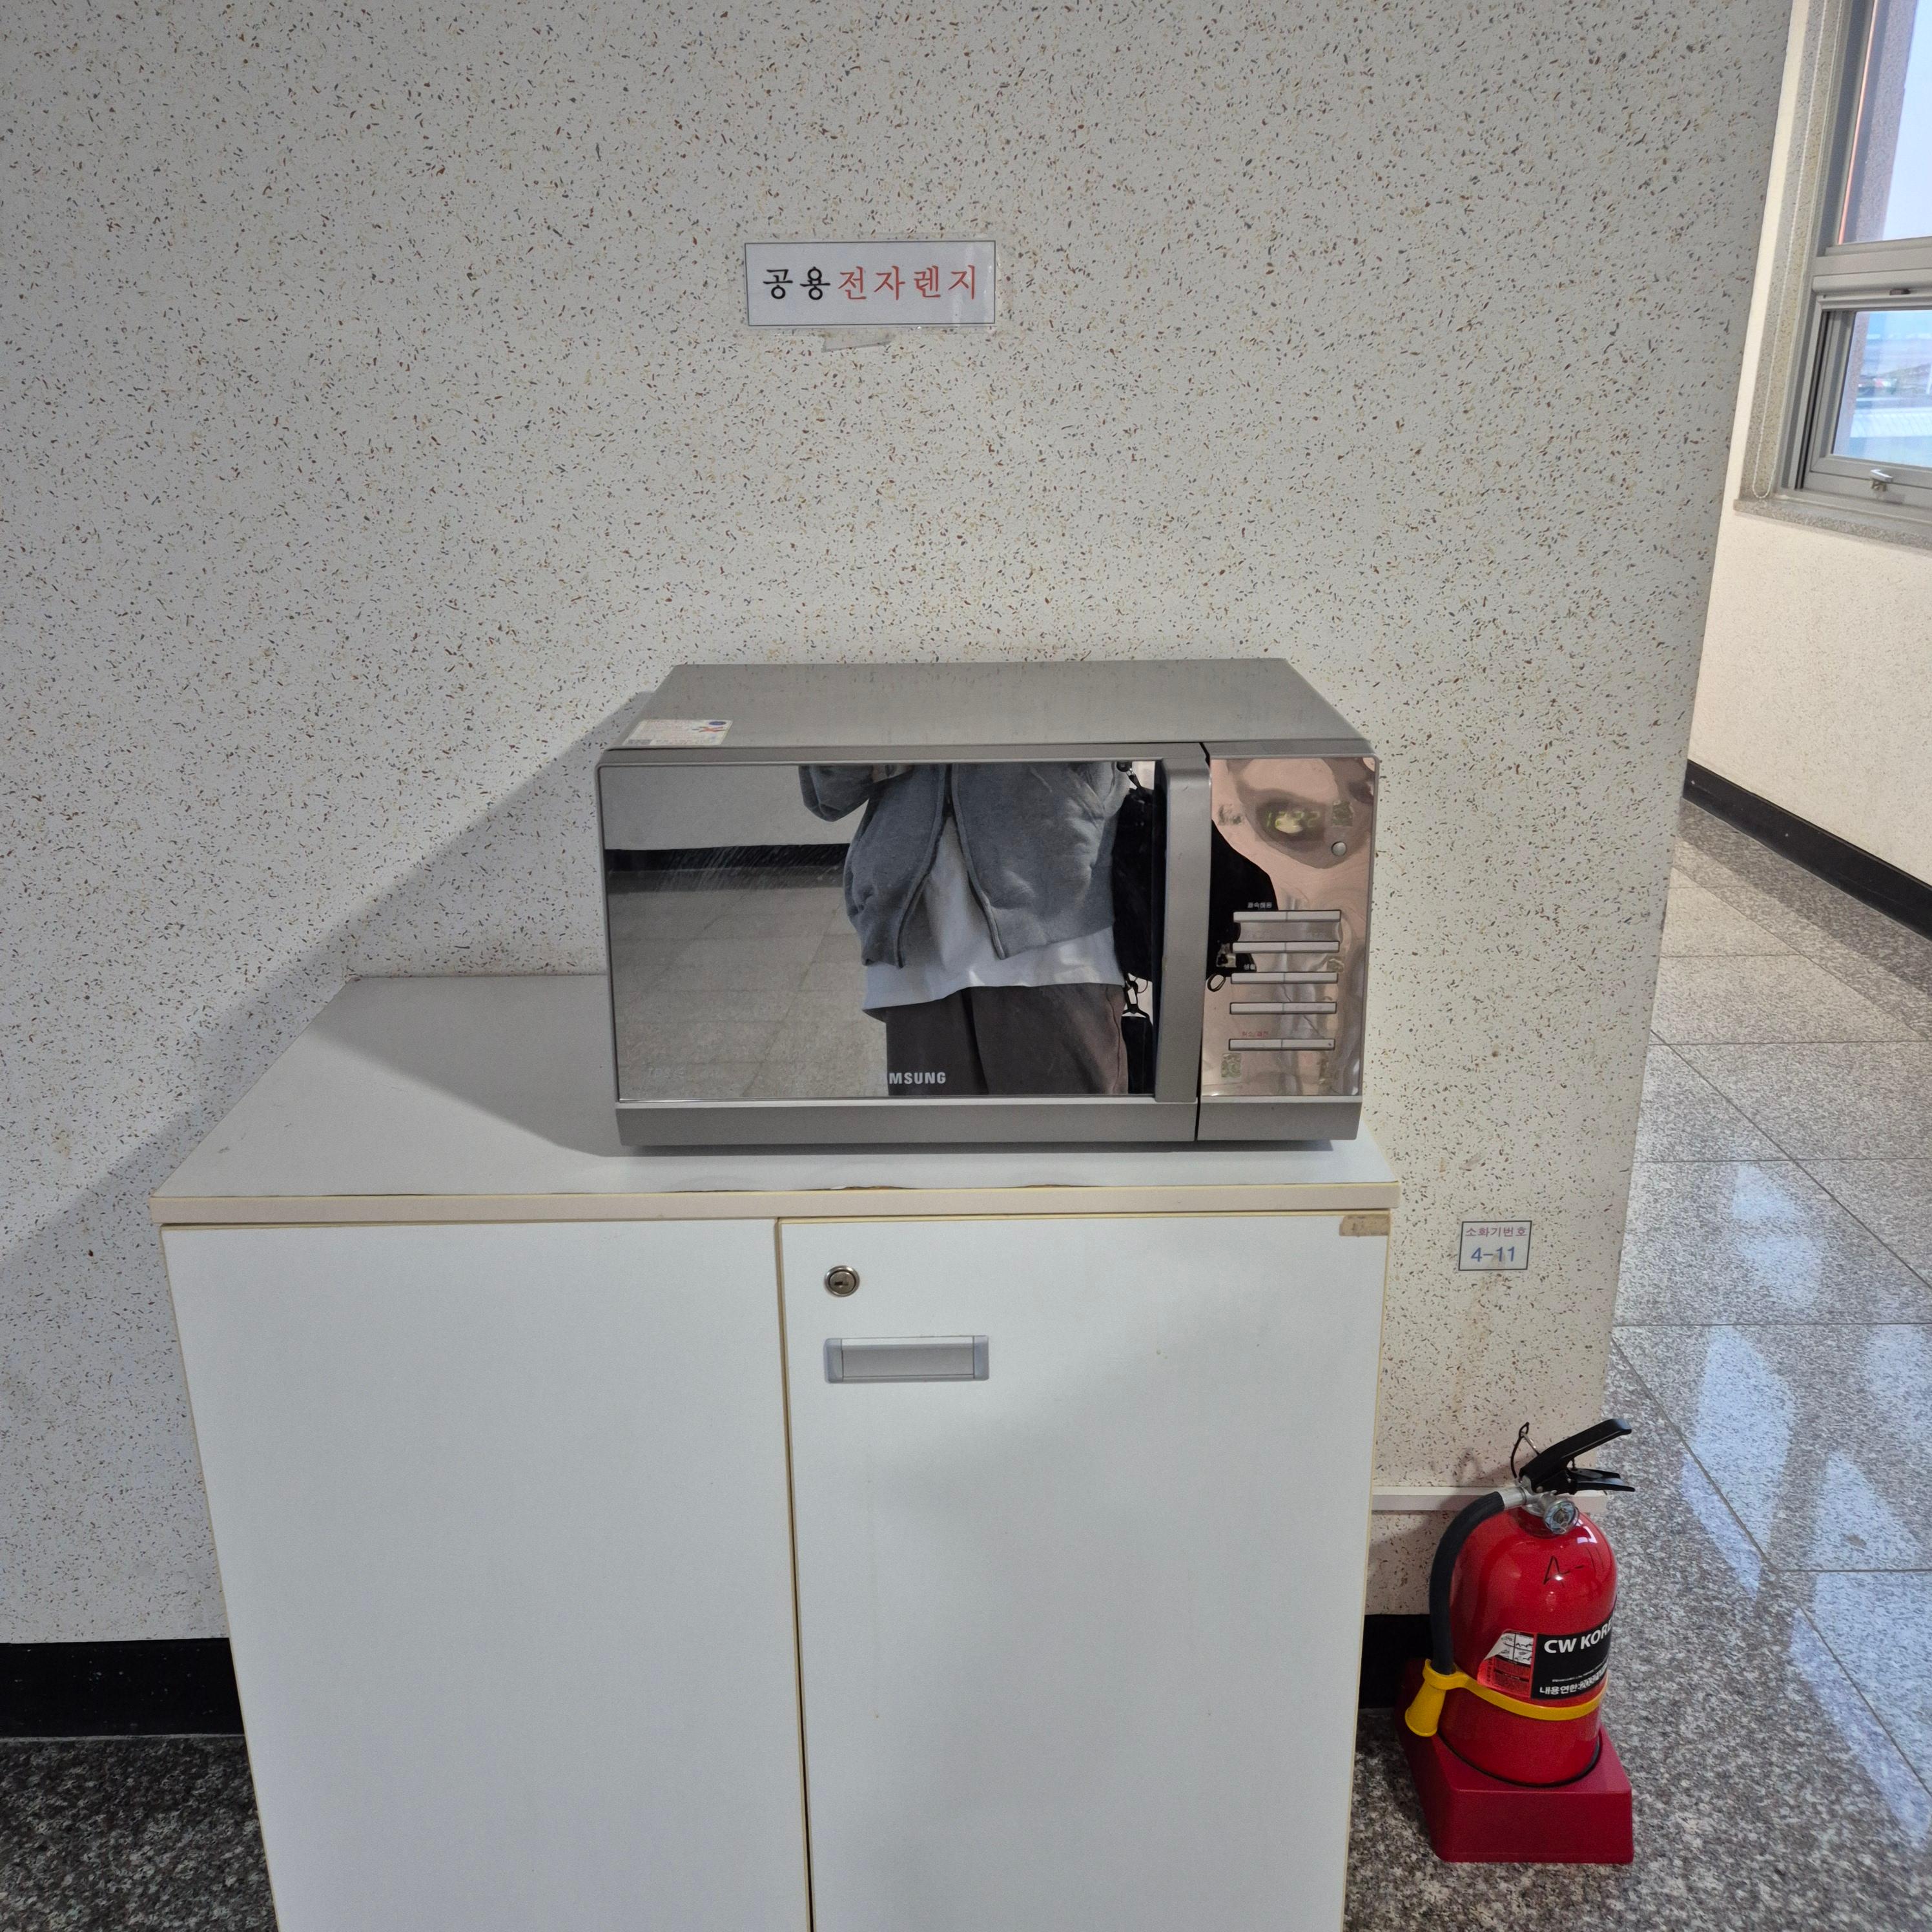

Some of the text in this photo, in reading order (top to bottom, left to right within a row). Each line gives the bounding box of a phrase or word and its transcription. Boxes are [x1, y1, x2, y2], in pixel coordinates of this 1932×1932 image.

[763, 265, 976, 300] 공용 전자렌지
[889, 1072, 947, 1085] MSUNG
[1465, 1226, 1528, 1238] 소화기번호
[1470, 1246, 1516, 1263] 4-11
[1543, 1616, 1613, 1654] CW KORE
